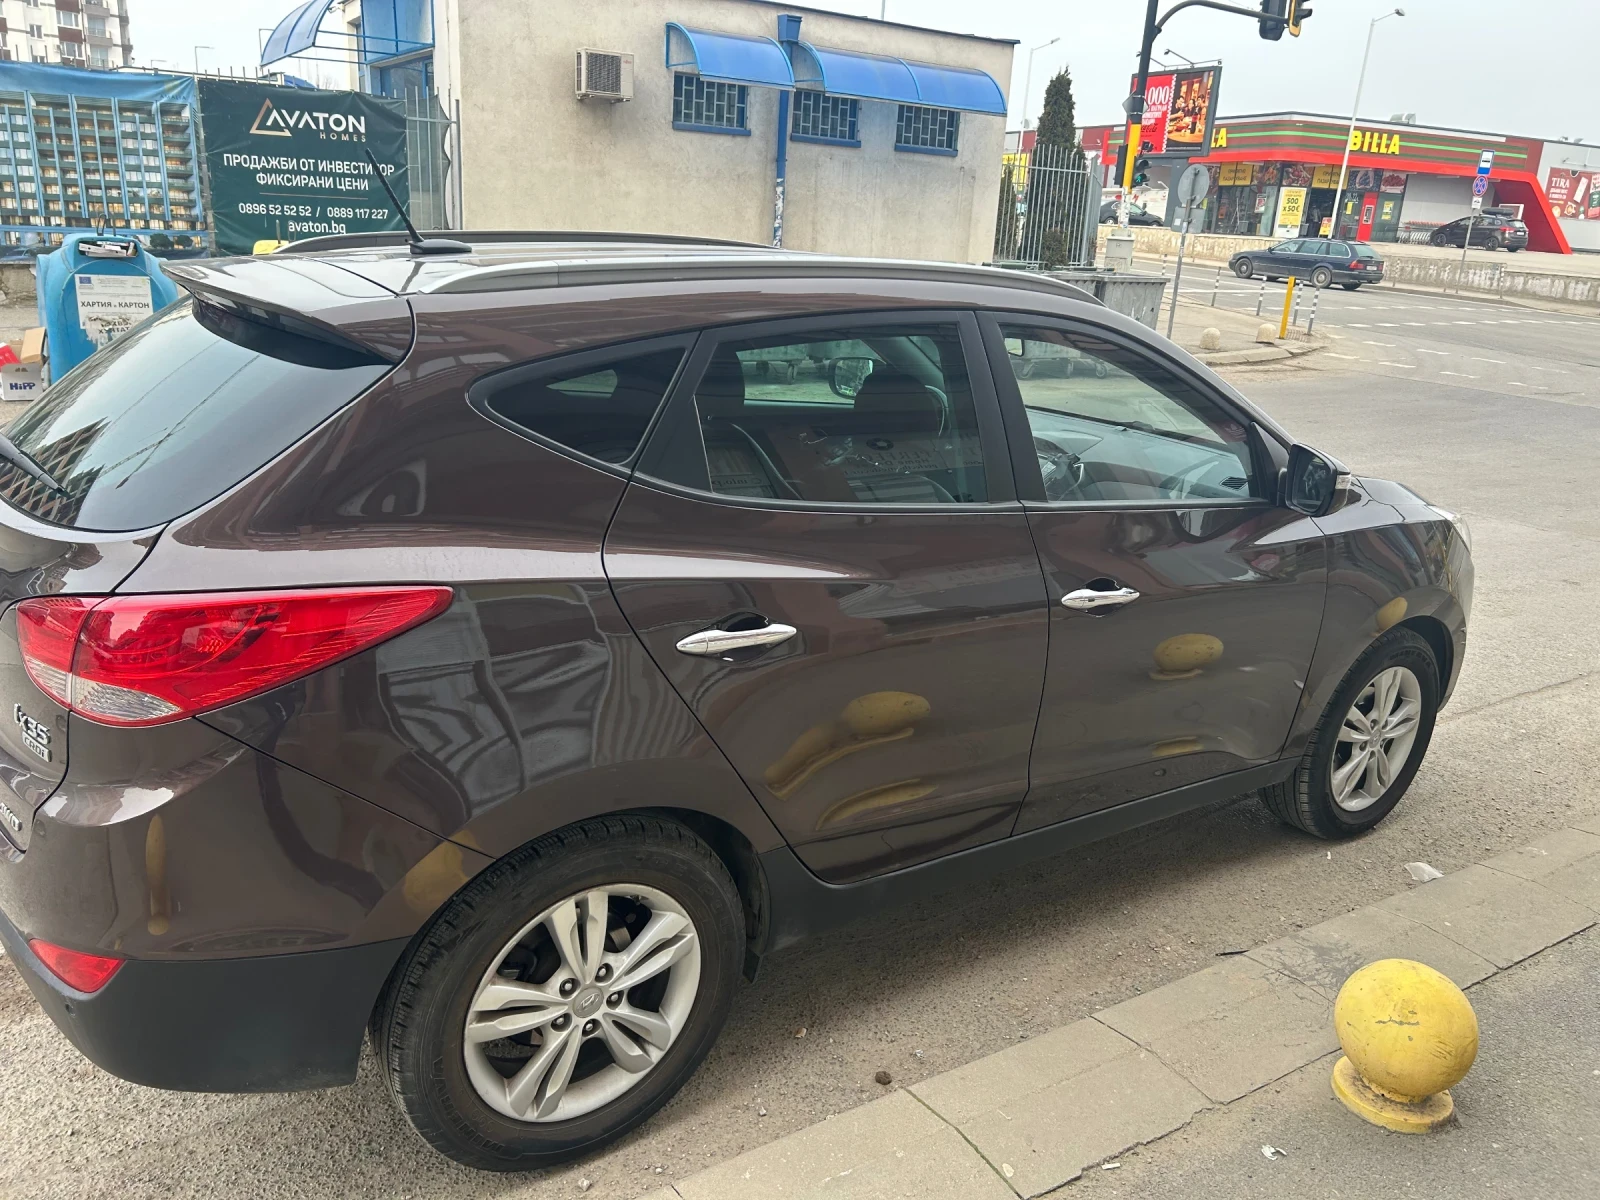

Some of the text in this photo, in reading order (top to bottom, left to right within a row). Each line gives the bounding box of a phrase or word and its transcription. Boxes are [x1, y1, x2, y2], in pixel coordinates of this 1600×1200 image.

[266, 108, 366, 134] AVATON
[319, 132, 367, 142] HOMES
[1349, 130, 1400, 155] BILLA
[223, 153, 395, 177] ПРОДАЖБИ ОТ ИНВЕСТИОР
[256, 172, 369, 192] ФИКСИРАНИ ЦЕНИ
[1286, 197, 1299, 205] 500
[238, 202, 389, 220] 0896 52 52 52 / 0889 117 227
[288, 220, 347, 235] avaton.bg
[118, 301, 150, 309] КАРТОН
[9, 382, 36, 391] HiPP
[14, 703, 51, 745] ix35
[24, 737, 46, 758] CRDi
